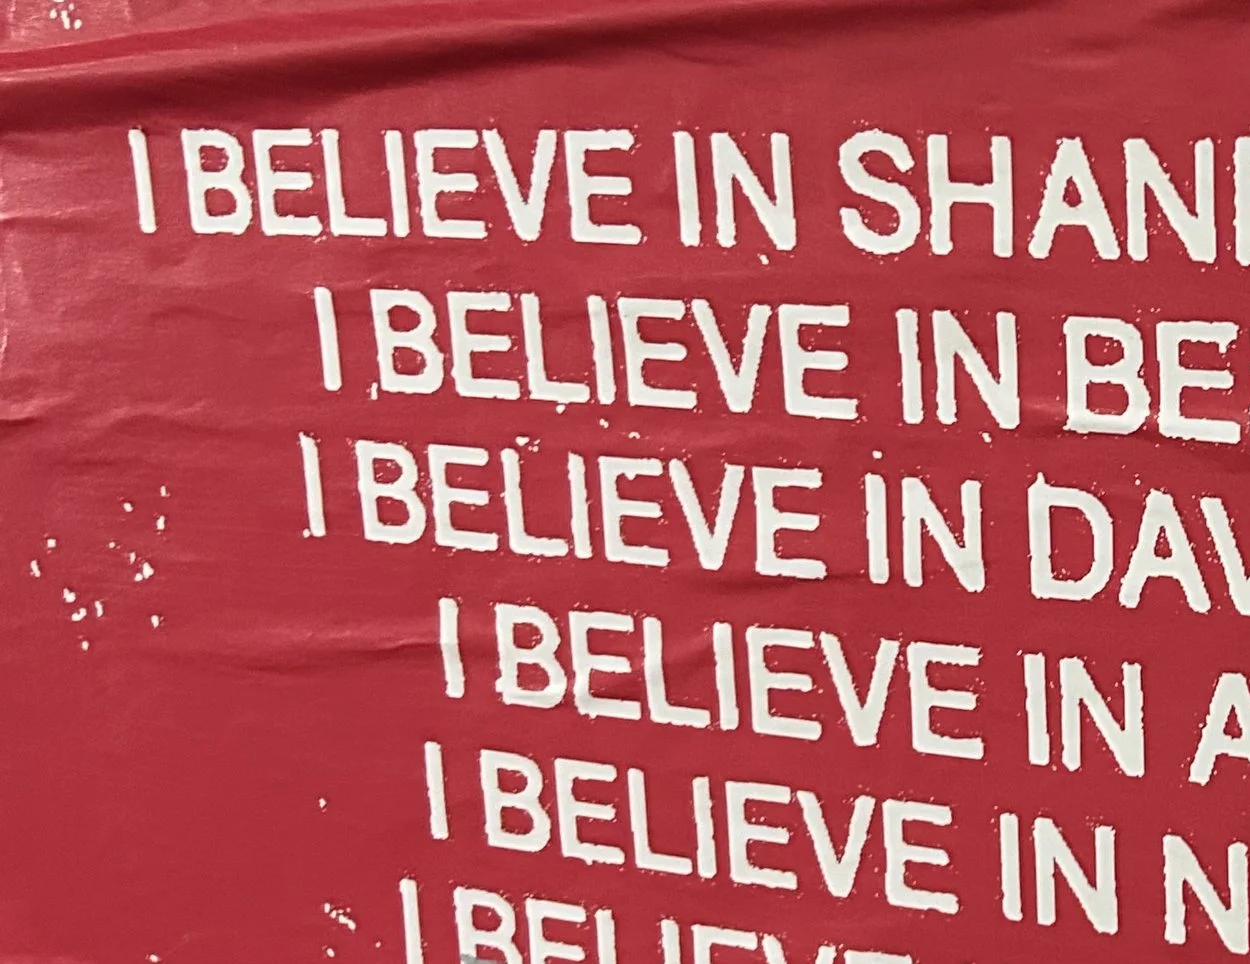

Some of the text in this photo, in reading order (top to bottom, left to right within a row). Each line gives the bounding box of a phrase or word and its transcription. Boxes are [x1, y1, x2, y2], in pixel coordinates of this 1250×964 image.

[128, 129, 157, 233] I
[180, 128, 642, 245] BELIEVE
[672, 131, 796, 250] IN
[312, 287, 342, 391] I
[369, 289, 858, 420] BELIEVE
[895, 309, 1020, 430] IN
[298, 433, 326, 538] I
[353, 440, 827, 579] BELIEVE
[865, 473, 985, 592] IN
[438, 597, 465, 698] I
[494, 603, 984, 759] BELIEVE
[1024, 652, 1144, 777] IN
[424, 741, 449, 840] I
[479, 749, 959, 914] BELIEVE
[1000, 813, 1118, 935] IN
